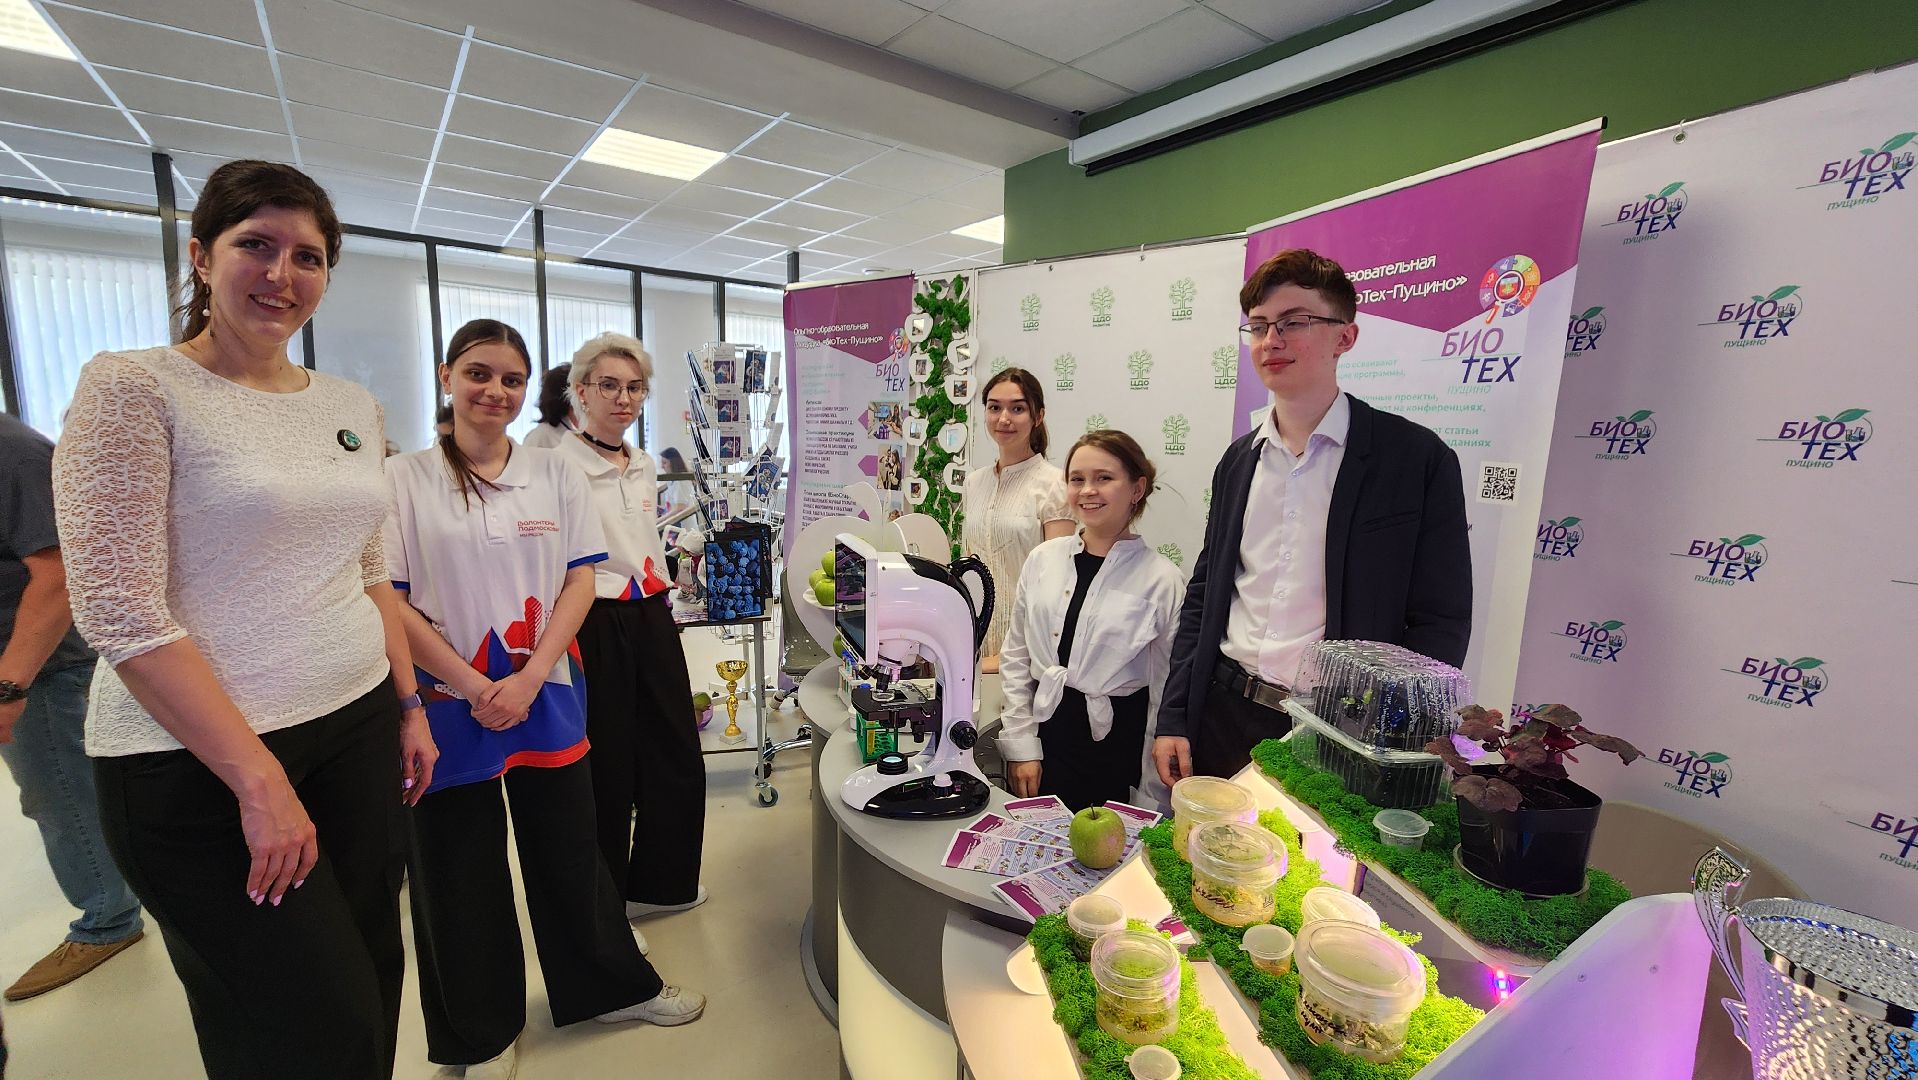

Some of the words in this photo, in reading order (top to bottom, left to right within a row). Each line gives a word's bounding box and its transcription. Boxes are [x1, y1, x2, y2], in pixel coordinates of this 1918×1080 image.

[1818, 150, 1893, 183] БИО
[1844, 168, 1913, 200] ТЕХ
[1617, 196, 1668, 222] БИО
[1826, 196, 1879, 211] ПУЩИНО
[1634, 211, 1682, 236] ТЕХ
[1344, 254, 1437, 283] азовательная
[1355, 275, 1468, 305] оТех-Пущино»
[1717, 299, 1779, 322] БИО
[1738, 318, 1795, 340] ТЕХ
[1441, 327, 1505, 357] БИО
[1723, 339, 1767, 348] ПУЩИНО
[876, 363, 900, 377] БИО
[1461, 355, 1523, 384] ТЕХ
[885, 377, 906, 392] ТЕХ
[1589, 421, 1638, 437] БИО
[1778, 421, 1847, 440] БИО
[1594, 453, 1630, 461] ПУЩИНО
[1606, 438, 1651, 455] ТЕХ
[1801, 442, 1864, 461] ТЕХ
[1785, 459, 1834, 469] ПУЩИНО
[1537, 523, 1568, 540] ИО
[1539, 539, 1579, 558] ТЕХ
[1687, 539, 1746, 561] БИО
[1694, 574, 1735, 587] ПУЩИНО
[1707, 559, 1760, 582] ТЕХ
[1564, 621, 1610, 643] БИО
[1580, 640, 1622, 663] ТЕХ
[1741, 657, 1804, 683] БИО
[1747, 693, 1792, 709] ПУЩИНО
[1762, 679, 1820, 708] ТЕХ
[1657, 748, 1711, 775] БИО
[1663, 781, 1702, 799] ПУЩИНО
[1675, 769, 1727, 799] ТЕХ
[1870, 812, 1918, 842] БИ
[1879, 853, 1918, 871] ПУЩИ
